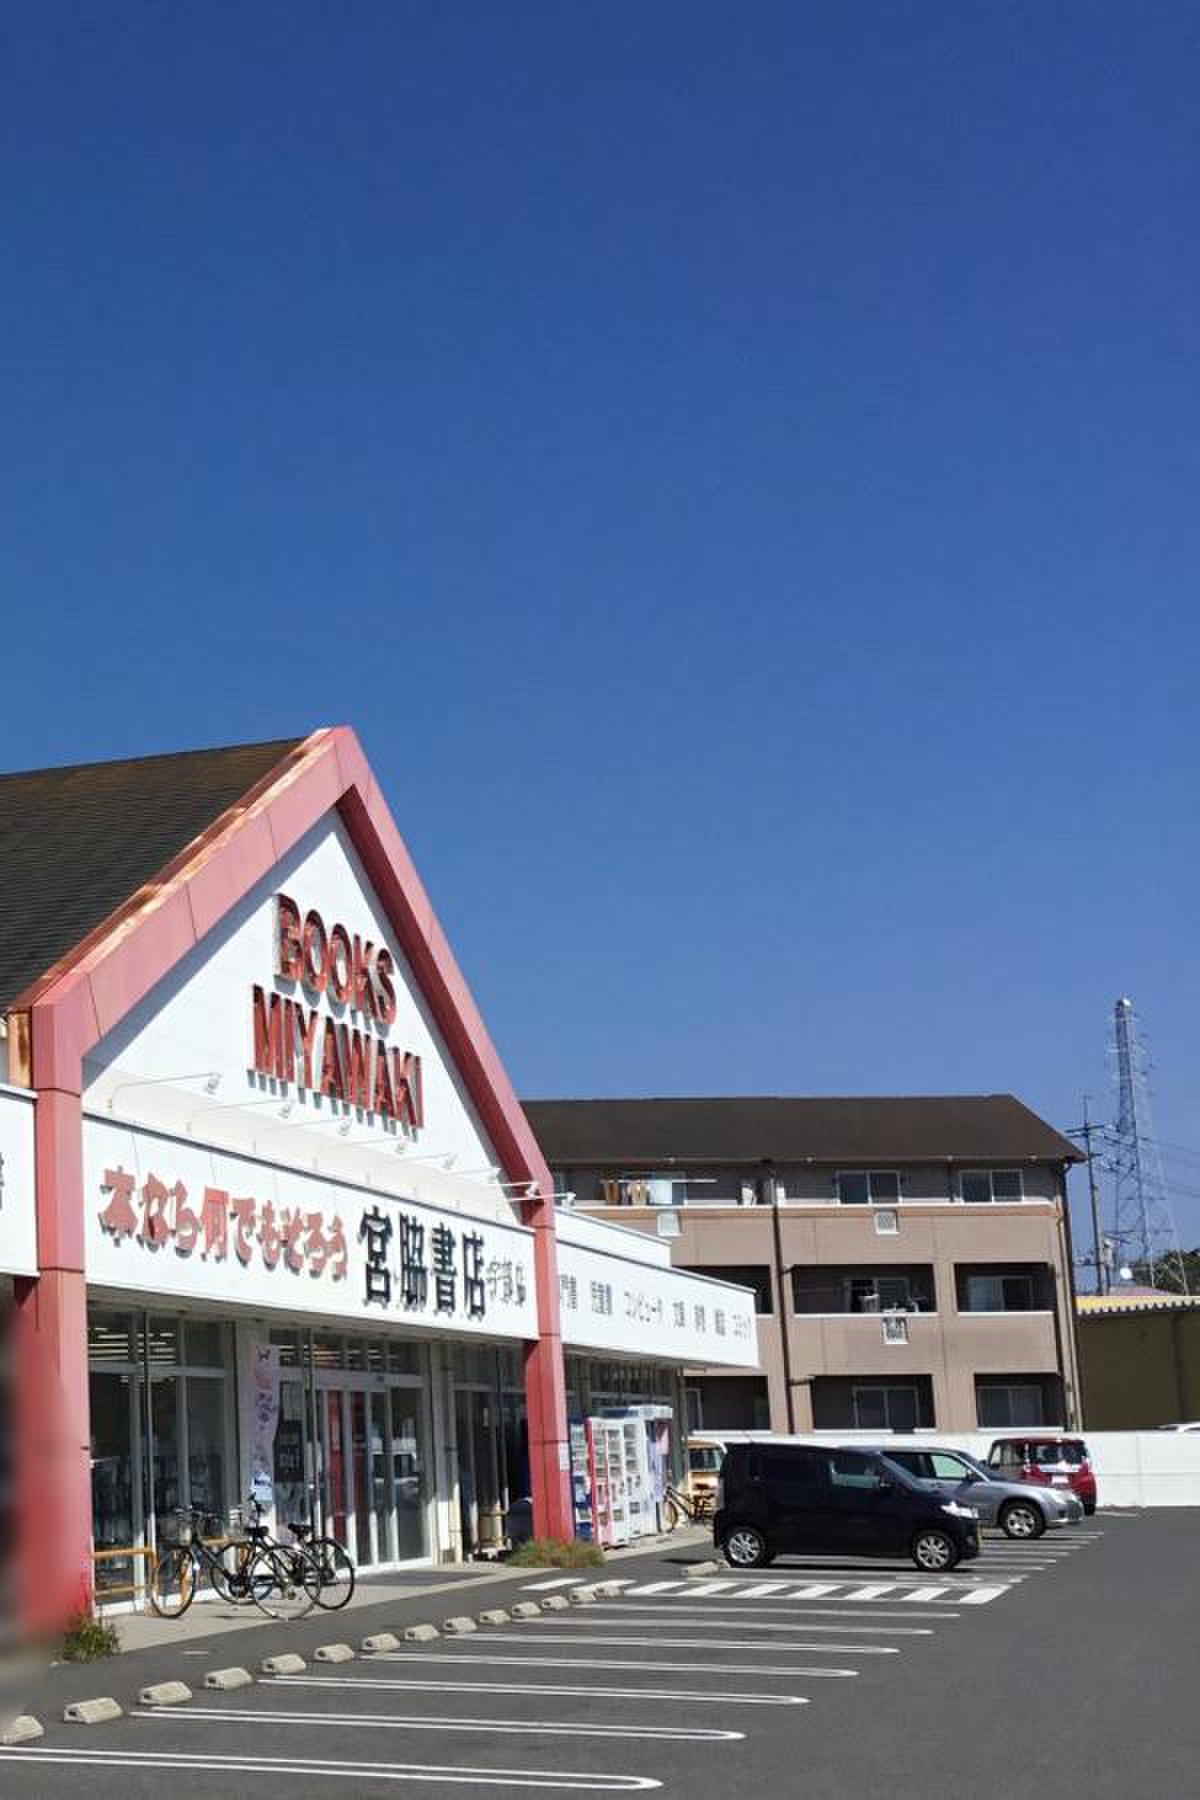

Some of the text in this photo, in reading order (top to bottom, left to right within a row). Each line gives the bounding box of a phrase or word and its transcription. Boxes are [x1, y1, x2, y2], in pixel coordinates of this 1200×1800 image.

[274, 893, 397, 1026] BOOKS
[252, 984, 425, 1130] MIYAWAKI
[100, 1165, 348, 1280] 本なら何でもそろう
[358, 1206, 487, 1318] 宮脇書店
